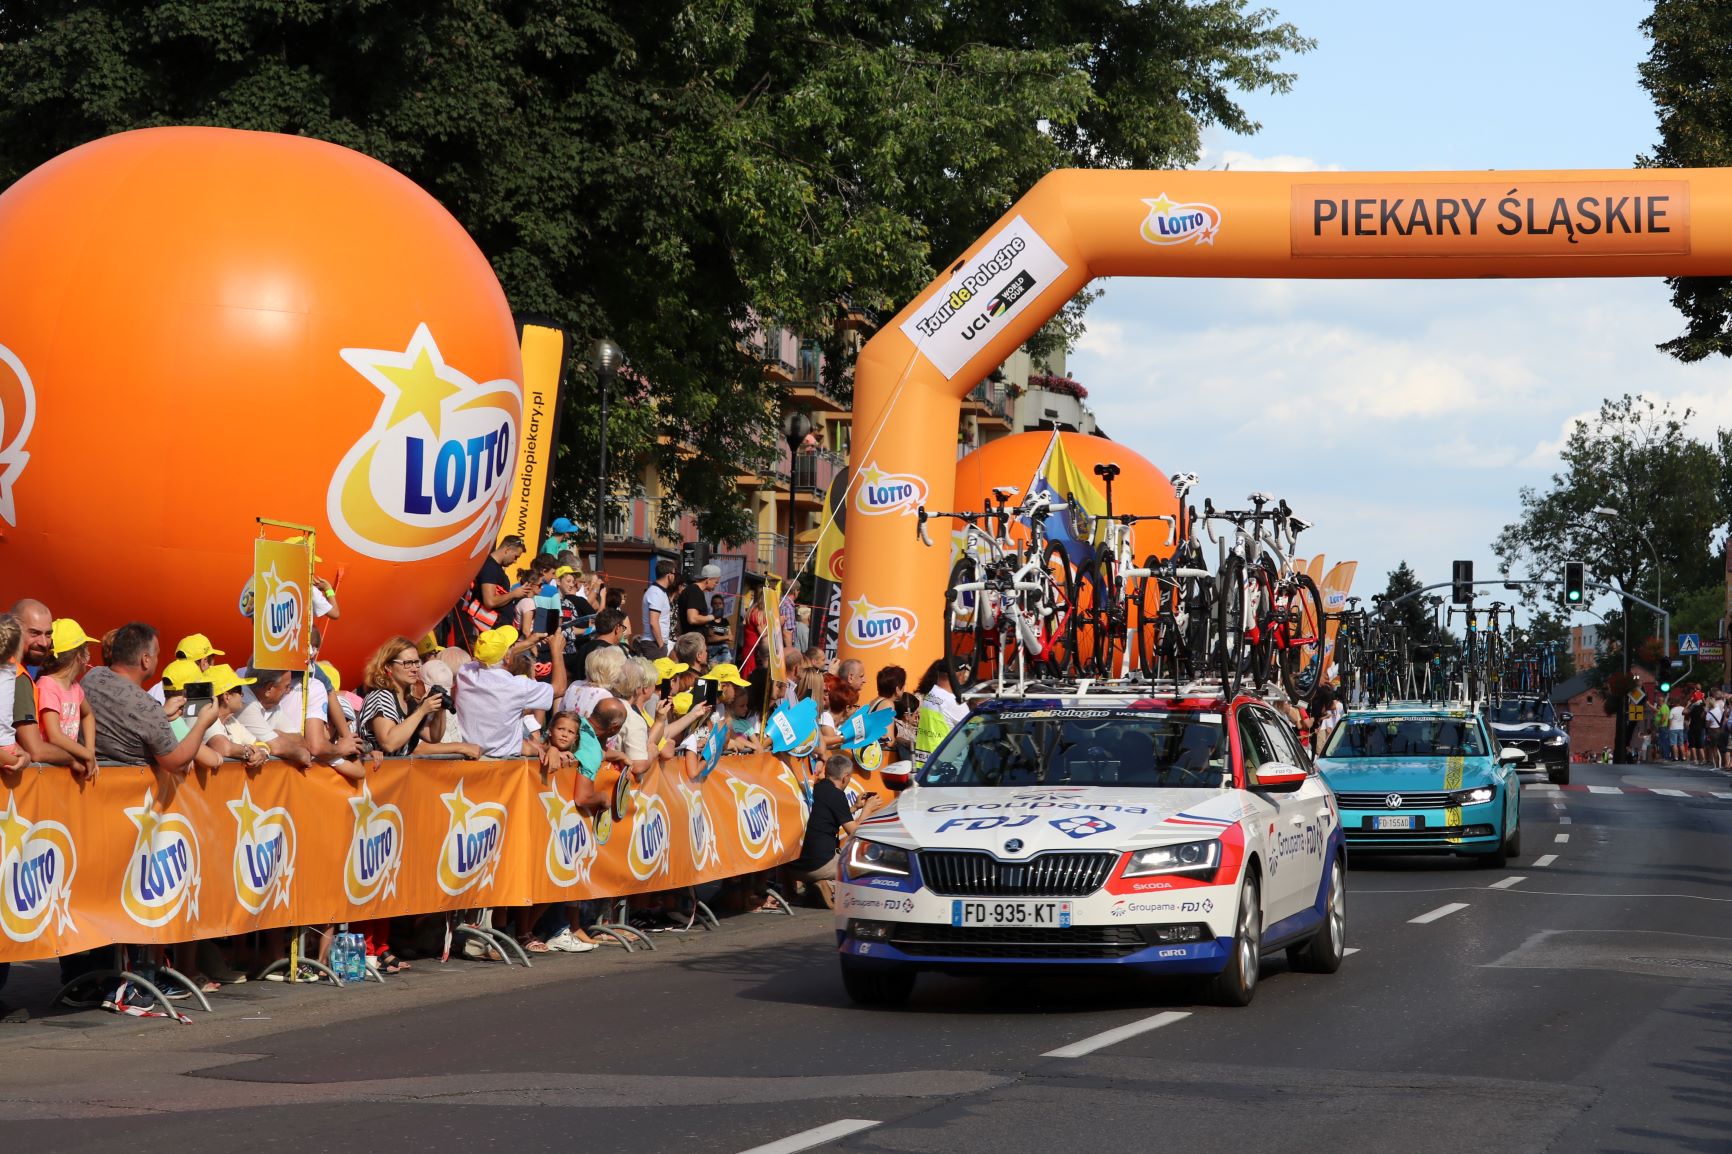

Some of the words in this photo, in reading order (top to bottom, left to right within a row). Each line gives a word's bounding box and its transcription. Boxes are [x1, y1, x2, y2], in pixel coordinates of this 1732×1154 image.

[1157, 212, 1204, 236] LOTTO
[1314, 198, 1486, 236] PIEKARY
[1496, 188, 1670, 244] ŚLĄSKIE
[916, 236, 1026, 337] TourdePologne
[1001, 275, 1025, 299] WORLD
[1006, 284, 1025, 303] TOUR
[960, 313, 991, 341] UCI
[404, 421, 509, 515] LOTTO
[868, 484, 912, 505] LOTTO
[270, 598, 294, 633] LOTTO
[858, 616, 901, 638] LOTTO
[927, 800, 1149, 815] Groupama
[641, 813, 664, 860] LOTTO
[934, 814, 1040, 834] FDJ
[246, 831, 283, 888] LOTTO
[359, 826, 392, 880] LOTTO
[457, 822, 497, 873] LOTTO
[12, 847, 55, 912] LOTTO
[140, 838, 187, 900] LOTTO
[884, 899, 901, 910] FDJ
[1128, 902, 1175, 912] Groupama
[1181, 902, 1200, 912] FDJ
[1060, 915, 1070, 925] 93
[1158, 949, 1187, 957] GIRO
